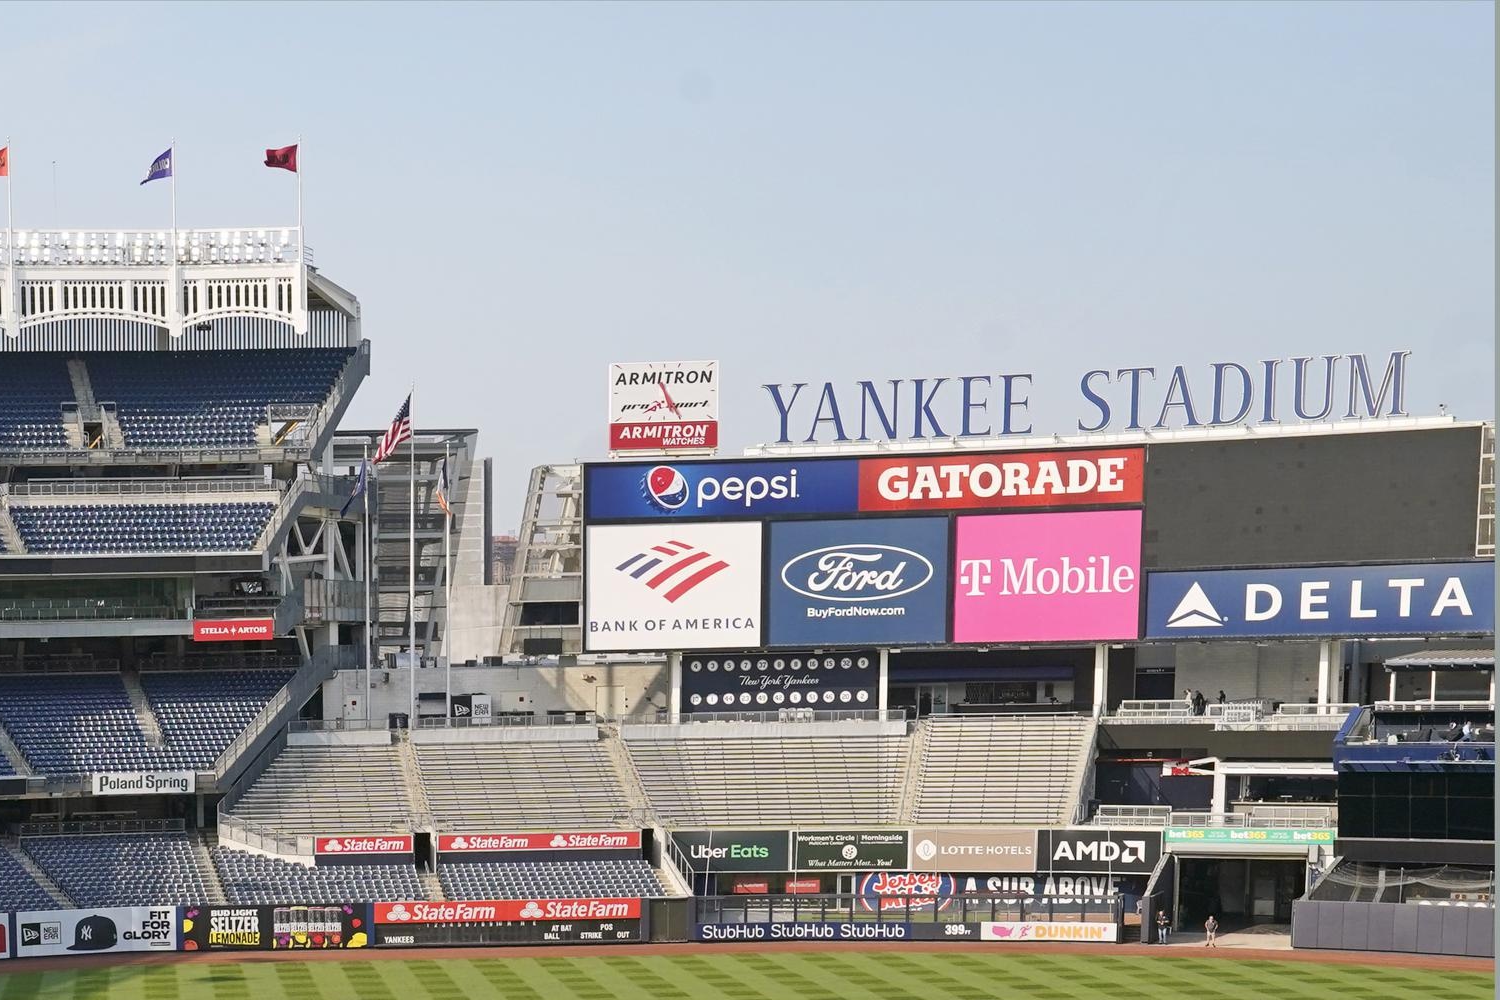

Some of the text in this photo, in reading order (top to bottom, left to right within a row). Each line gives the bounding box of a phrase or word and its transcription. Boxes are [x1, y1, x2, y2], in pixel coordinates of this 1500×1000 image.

[615, 370, 713, 386] ARMITRON
[761, 350, 1412, 444] YANKEE STADIUM
[619, 424, 708, 439] ARMITRON
[662, 437, 706, 445] WATCHES
[696, 458, 1127, 508] pepsi GATORADE
[807, 551, 904, 595] Ford
[1245, 577, 1474, 622] DELTA
[807, 606, 906, 620] BuyFordNow.com
[590, 618, 755, 633] BANK OF AMERICA
[739, 674, 820, 689] New York Yankees
[100, 774, 188, 792] Poland Spring
[1168, 830, 1205, 839] bet365
[1230, 830, 1267, 839] bet365
[1293, 831, 1330, 840] bet365
[690, 844, 769, 859] Uber Eats
[941, 844, 1032, 856] LOTTE HOTELS
[1053, 840, 1120, 861] AMD
[873, 870, 942, 892] Jersey
[964, 877, 979, 905] A
[986, 876, 1035, 905] SUB
[150, 911, 170, 920] FIT
[142, 921, 170, 930] FOR
[210, 916, 259, 933] SELTZER
[702, 924, 905, 939] StubHub StubHub StubHub
[123, 930, 170, 940] GLORY
[210, 932, 259, 944] LEMONADE
[384, 936, 415, 944] YANKEES
[544, 932, 560, 940] BALL
